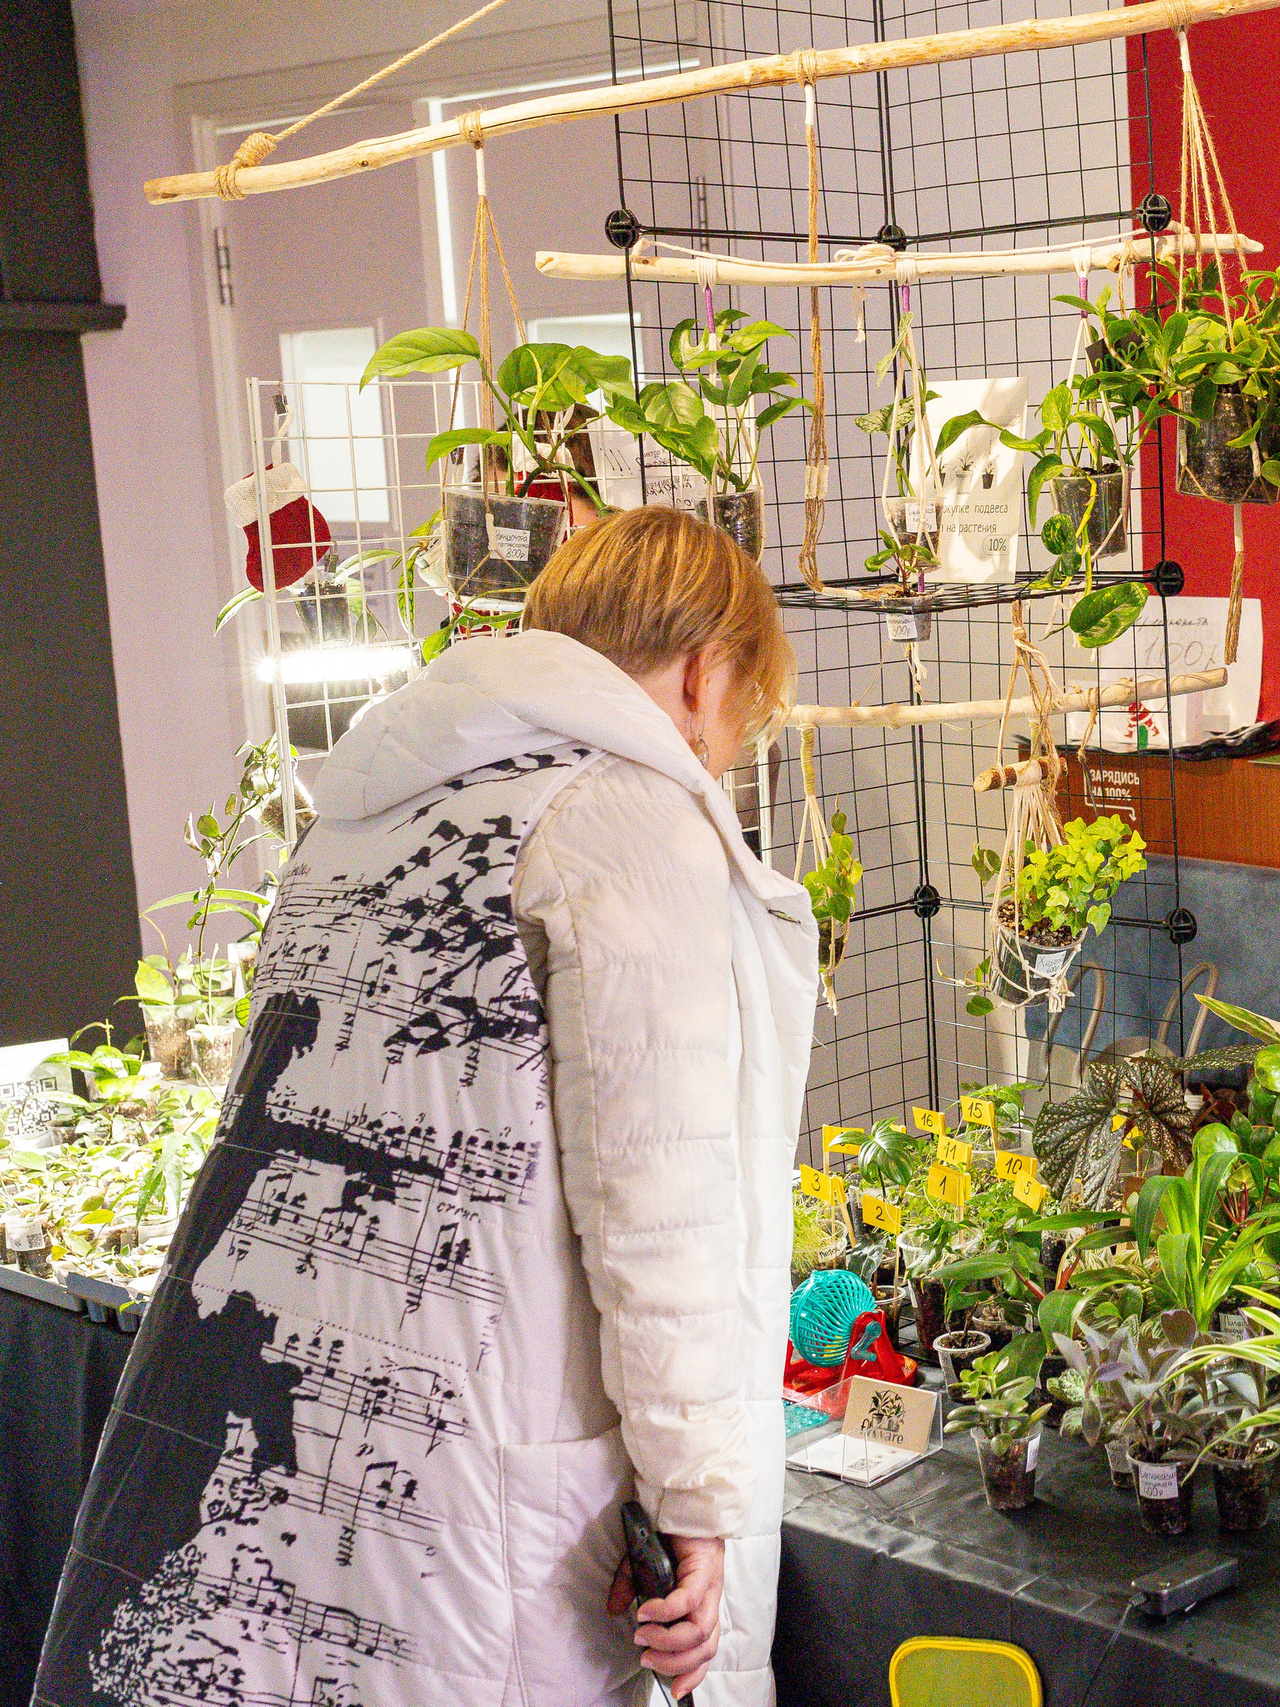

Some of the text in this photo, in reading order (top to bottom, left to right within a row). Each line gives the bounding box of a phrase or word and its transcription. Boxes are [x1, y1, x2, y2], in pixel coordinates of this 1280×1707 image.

[942, 503, 970, 518] окупке
[974, 503, 1009, 515] подвеса
[946, 525, 957, 533] на
[959, 523, 998, 536] растения
[988, 538, 1008, 552] 10%
[1089, 769, 1140, 785] ЗАРЯДИСЬ
[1091, 786, 1132, 802] НА 100%
[967, 1102, 983, 1119] 15
[920, 1112, 934, 1128] 16
[944, 1141, 957, 1160] 11
[1005, 1157, 1023, 1175] 10
[811, 1173, 821, 1192] 3
[939, 1175, 947, 1196] 1
[1023, 1181, 1033, 1196] 5
[875, 1205, 885, 1222] 2
